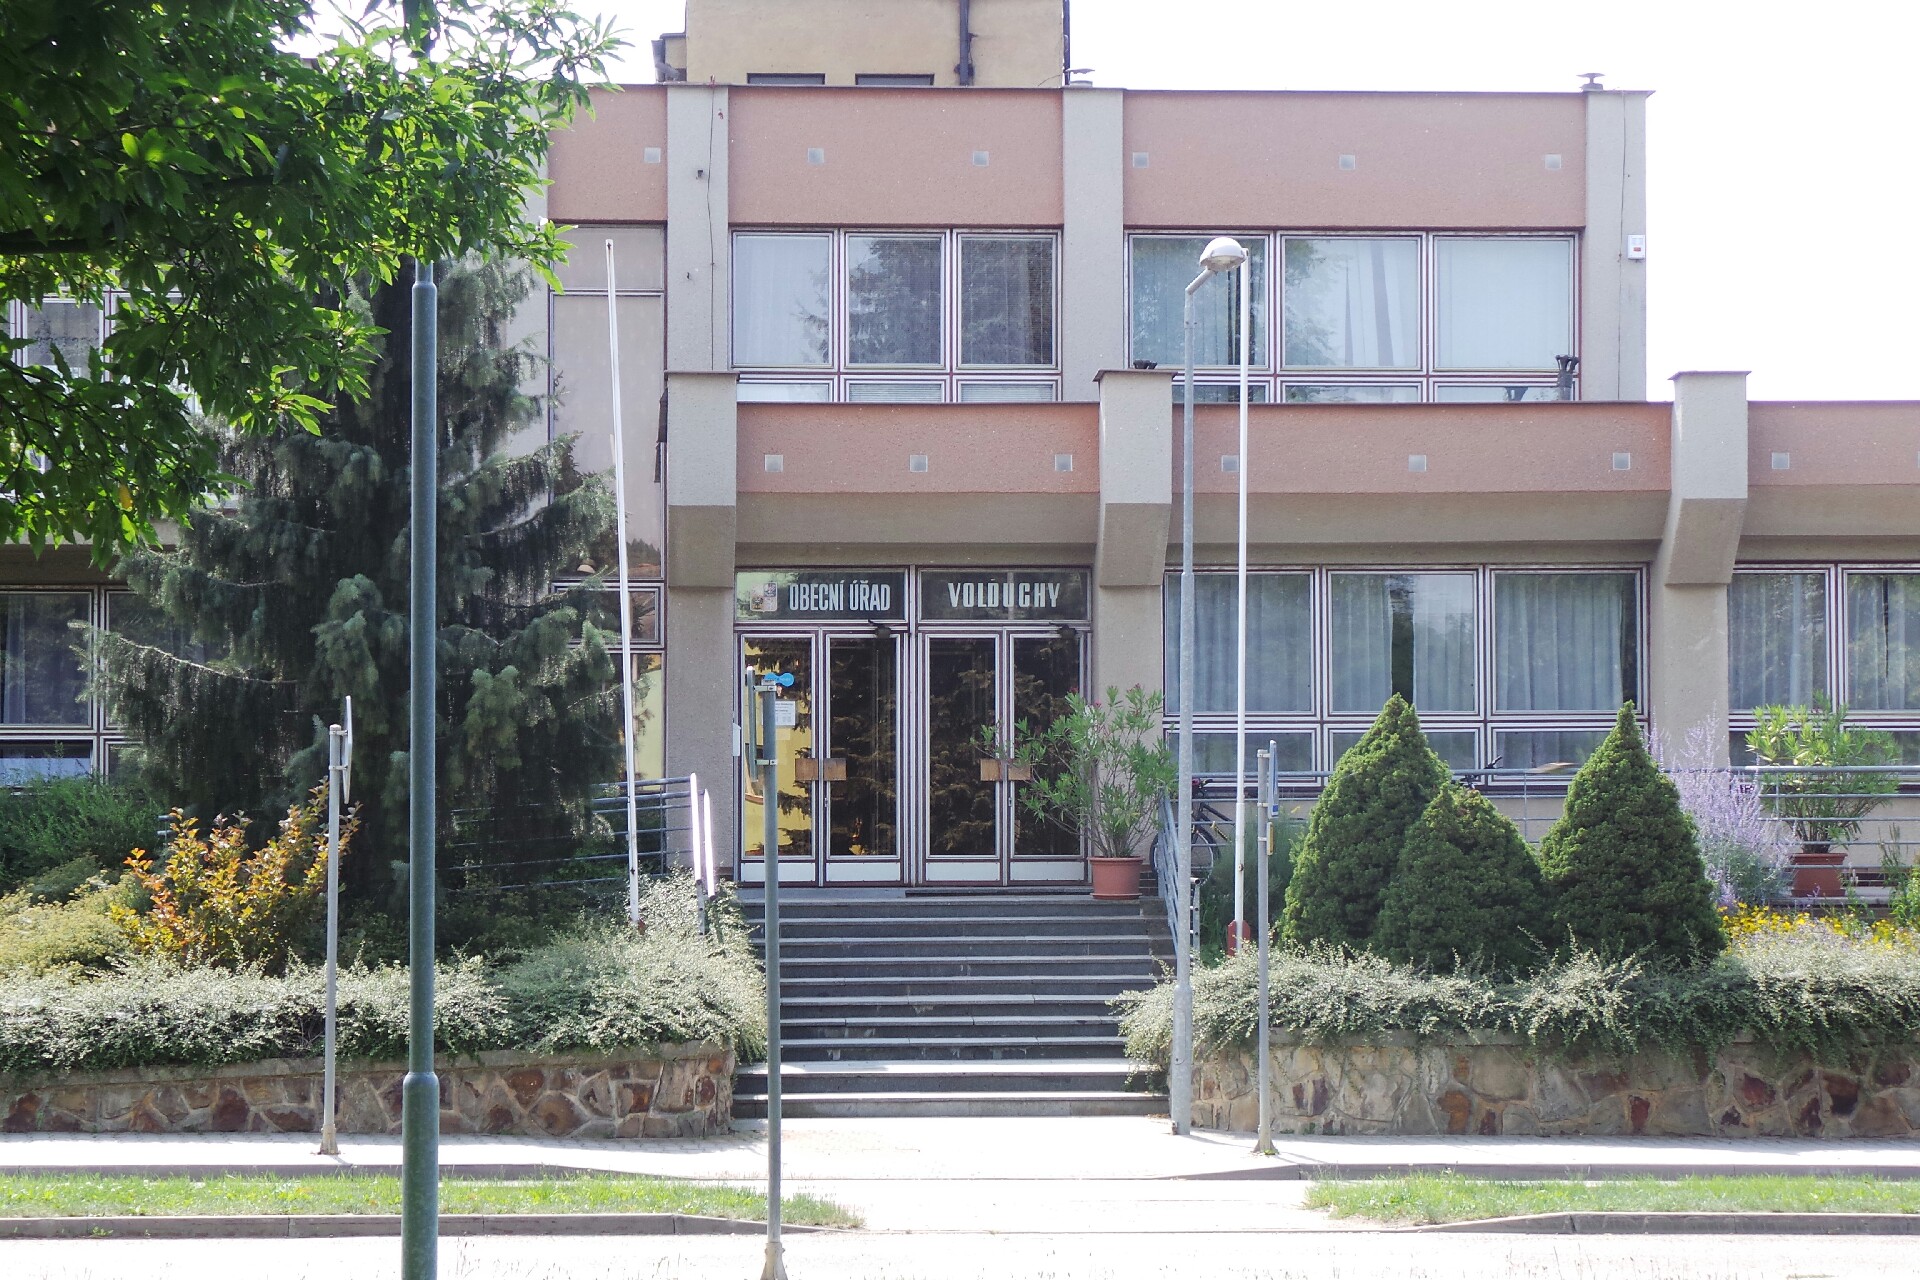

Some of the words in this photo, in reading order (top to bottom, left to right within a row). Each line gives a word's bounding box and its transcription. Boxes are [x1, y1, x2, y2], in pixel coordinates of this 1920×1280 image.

[789, 580, 845, 611] OBECNÍ
[849, 580, 891, 611] ÚŘAD
[947, 582, 1061, 608] VOLDUCHY
